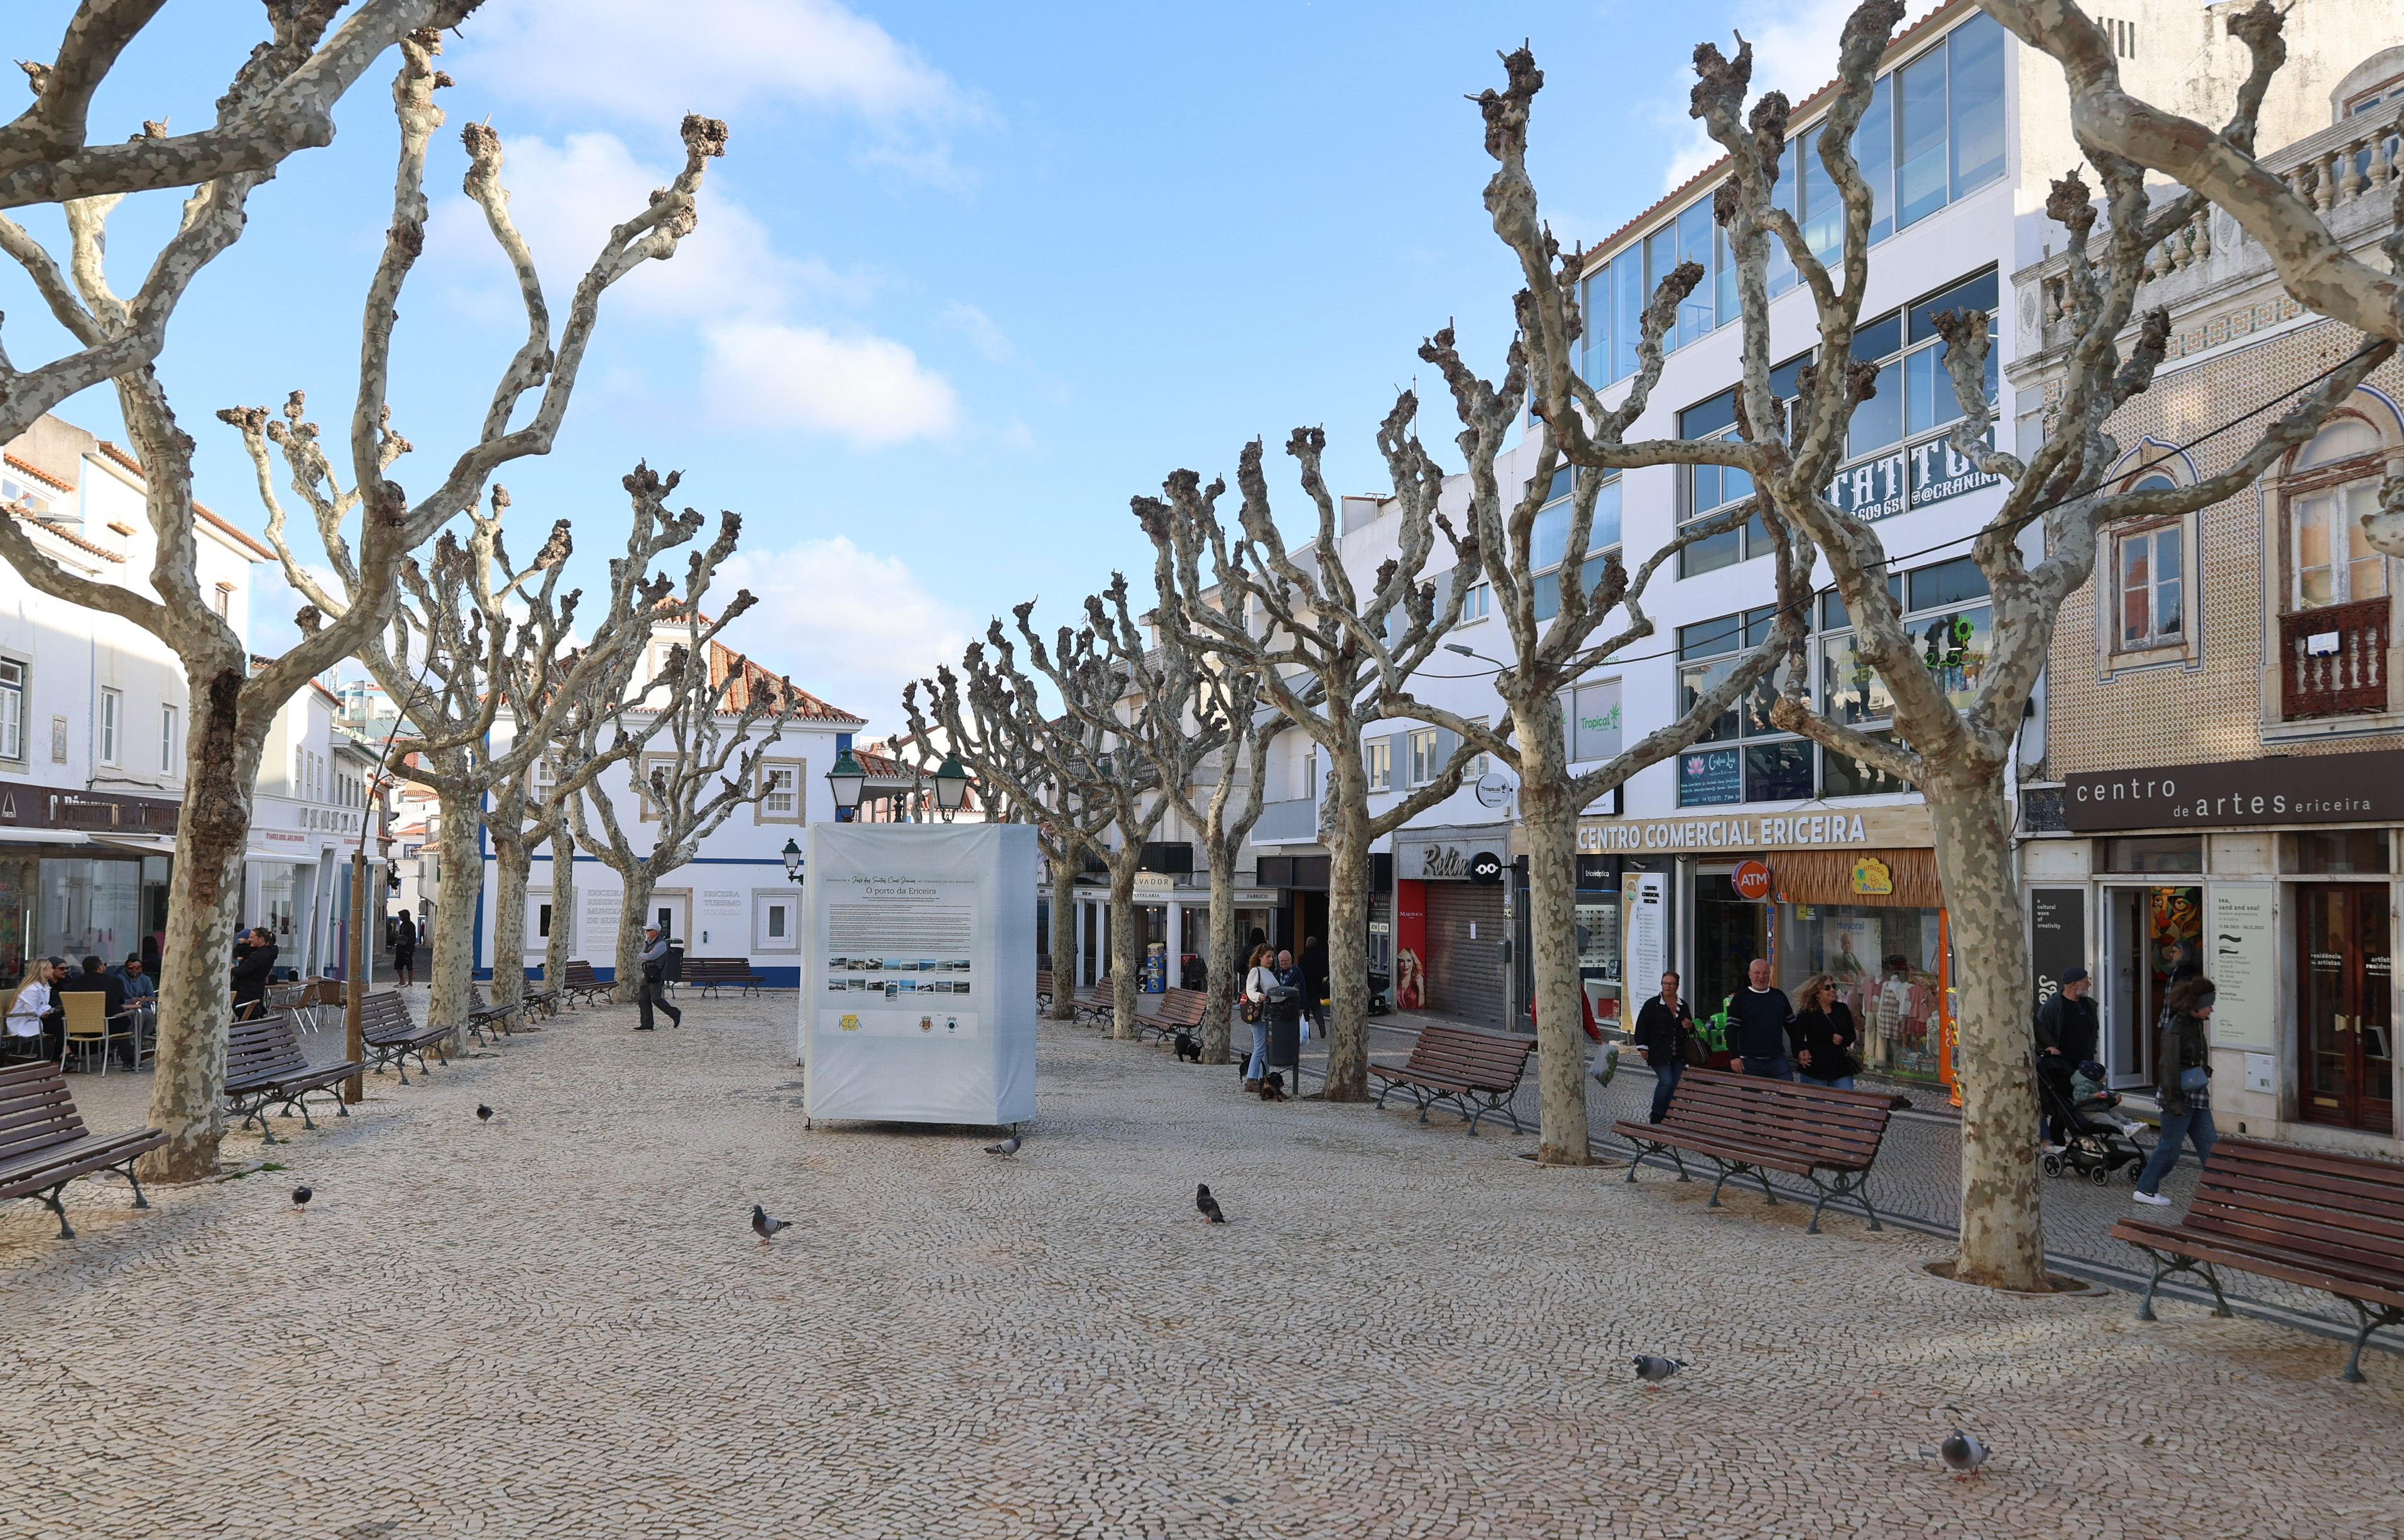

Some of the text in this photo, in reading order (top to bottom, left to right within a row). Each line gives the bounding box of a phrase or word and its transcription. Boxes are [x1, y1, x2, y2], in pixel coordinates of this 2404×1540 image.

[1580, 714, 1610, 730] Tropical
[2076, 778, 2175, 802] centro
[2173, 792, 2371, 817] de artes ericeira
[1578, 814, 1866, 849] CENTRO COMERCIAL ERICEIRA
[1740, 872, 1767, 887] ATM
[1837, 921, 1865, 932] mayoral
[838, 1018, 862, 1029] ICEA
